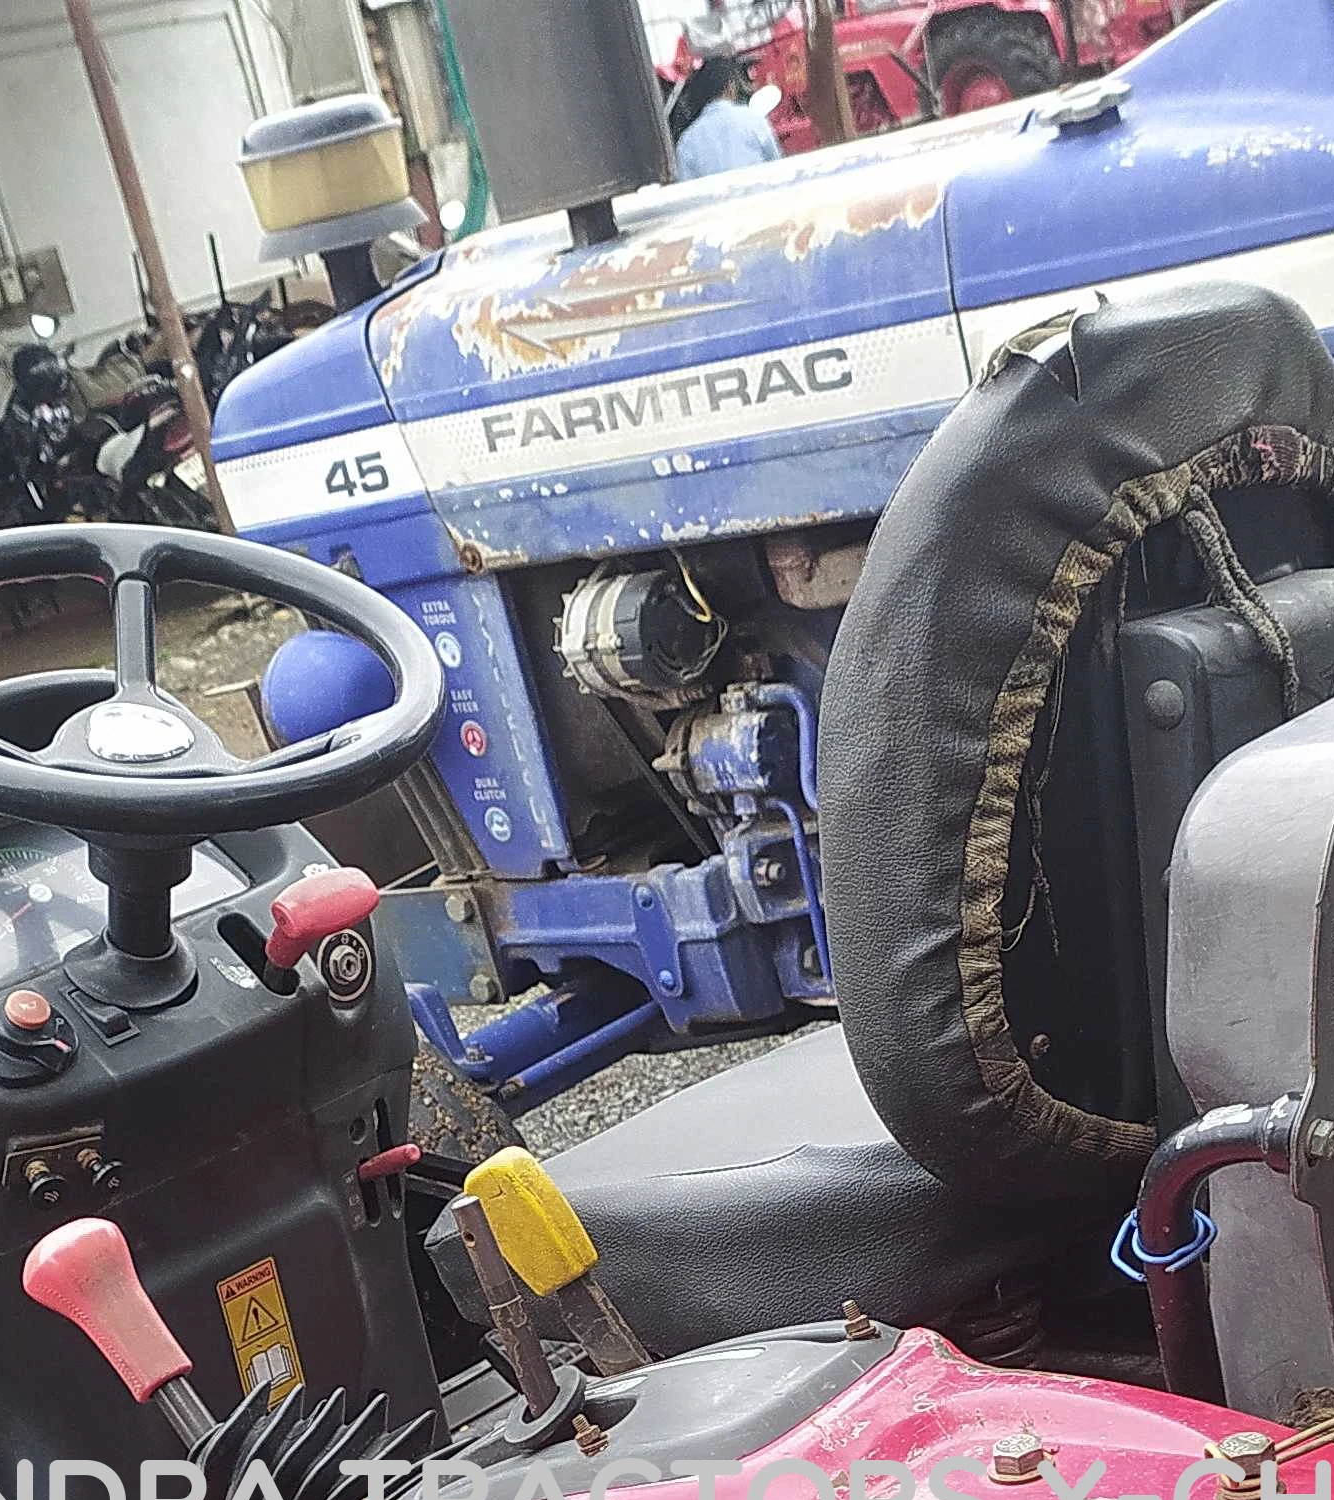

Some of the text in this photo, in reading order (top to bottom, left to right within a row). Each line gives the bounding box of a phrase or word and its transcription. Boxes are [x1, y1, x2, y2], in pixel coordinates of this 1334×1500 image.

[482, 347, 853, 453] FARMTRAC
[324, 450, 389, 498] 45
[234, 1266, 272, 1291] WARNING
